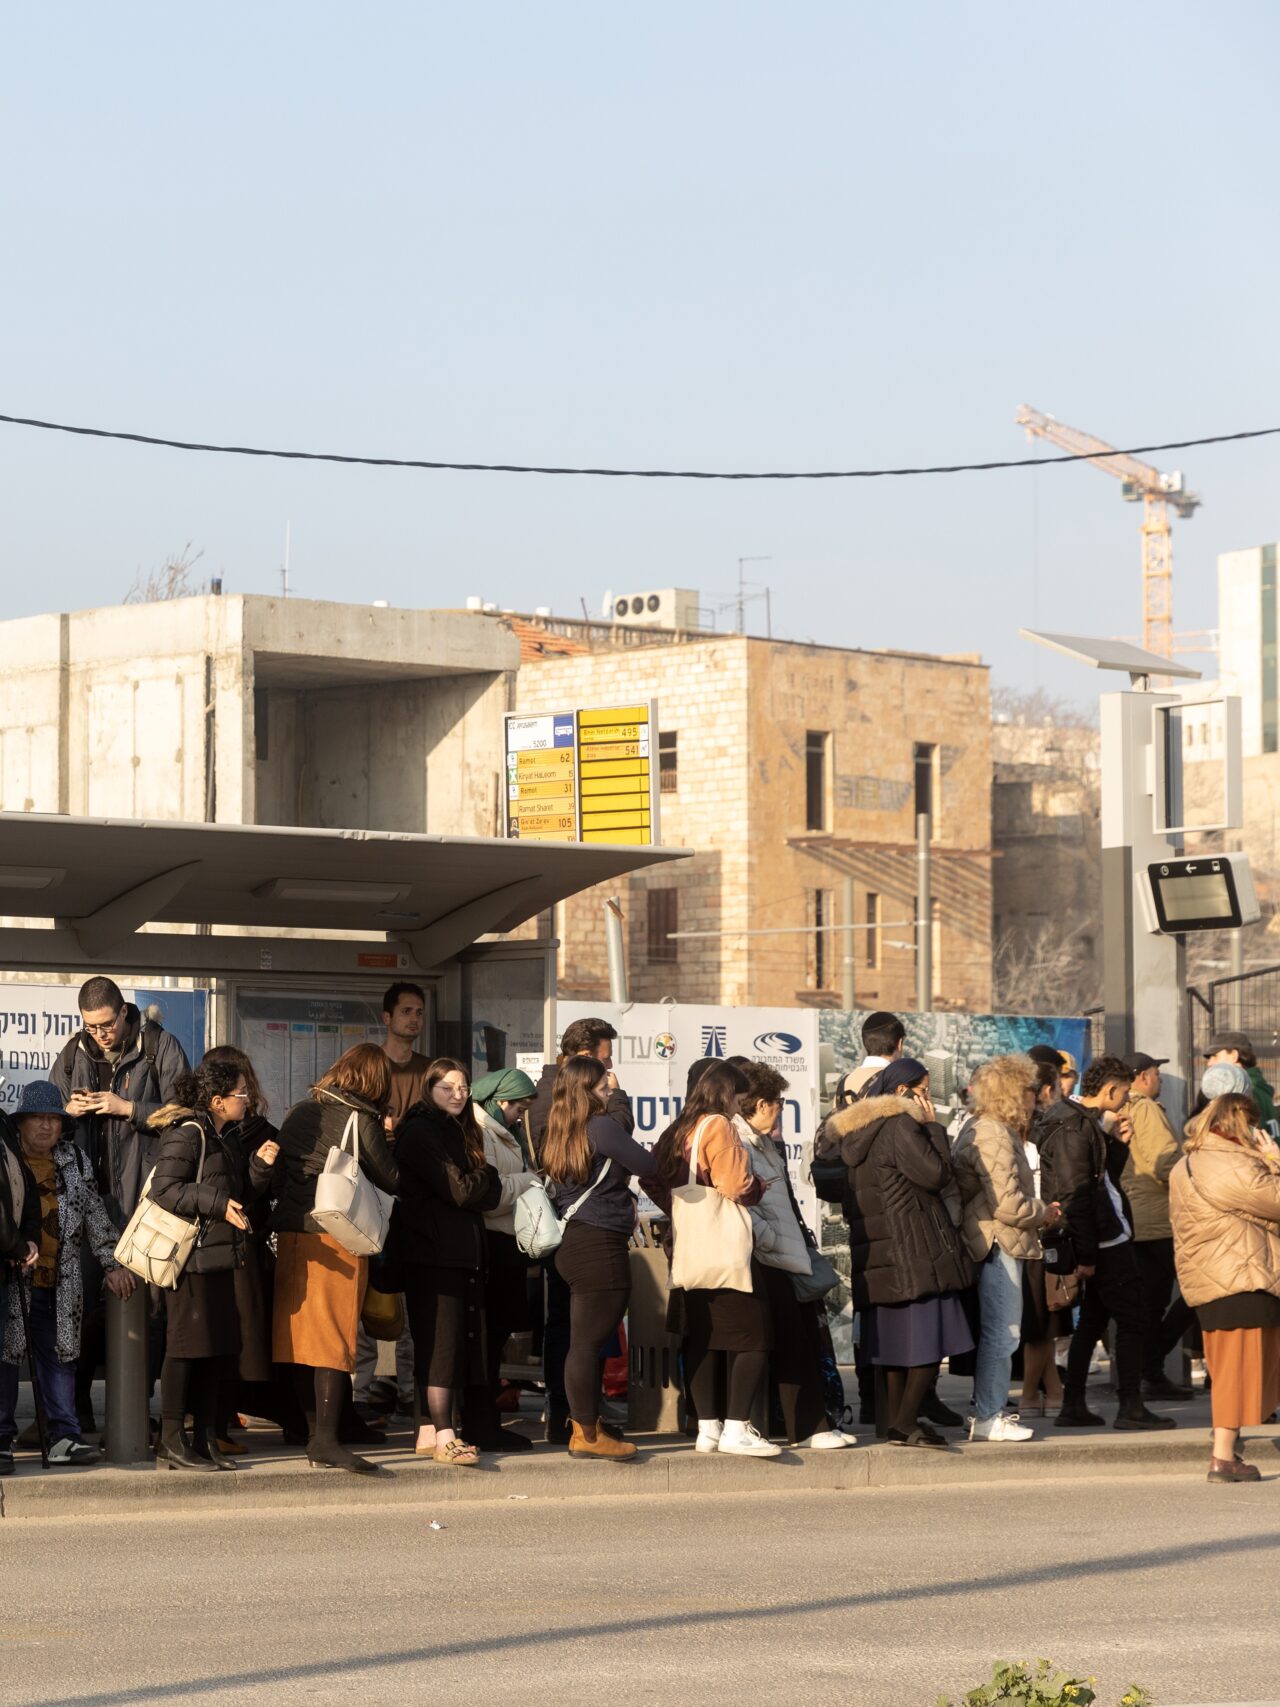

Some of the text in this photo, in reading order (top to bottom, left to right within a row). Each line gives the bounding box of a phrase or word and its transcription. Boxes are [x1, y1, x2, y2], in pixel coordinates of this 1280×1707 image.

[621, 727, 638, 737] 495
[532, 739, 547, 748] 5200
[625, 745, 639, 755] 541
[519, 753, 570, 765] Ramot 62
[519, 772, 533, 781] Kiryat
[520, 783, 572, 795] Ramot 31
[558, 818, 572, 828] 105
[43, 1011, 81, 1036] יהול
[9, 1051, 50, 1070] עמרם
[785, 1056, 805, 1064] משרד
